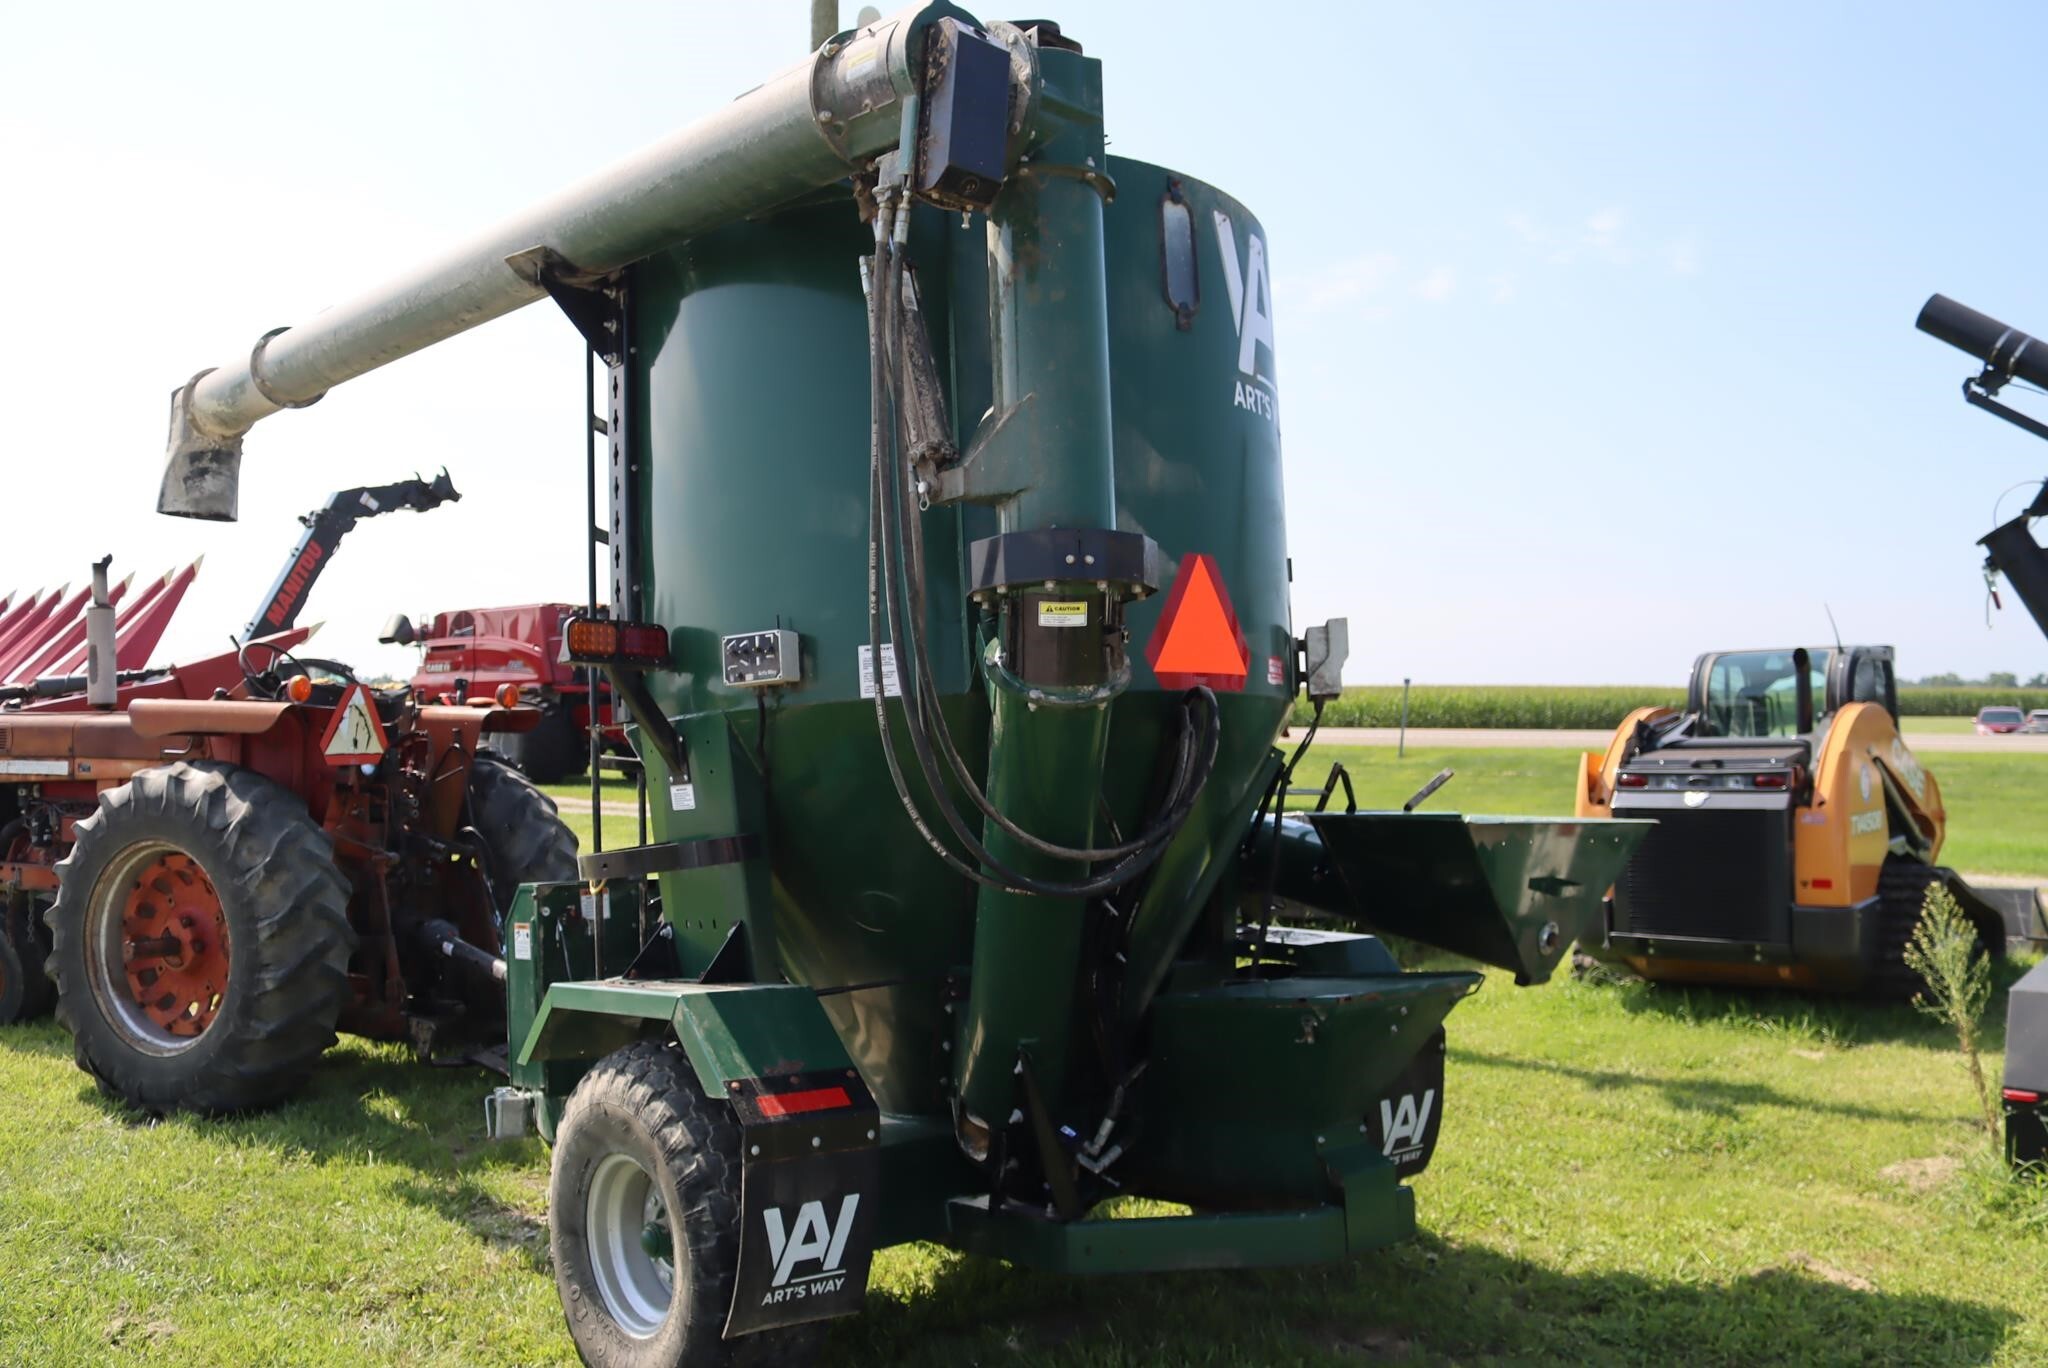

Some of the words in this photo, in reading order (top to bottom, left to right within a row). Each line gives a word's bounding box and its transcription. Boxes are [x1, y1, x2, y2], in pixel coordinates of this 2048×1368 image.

[1234, 380, 1271, 421] ART'S
[266, 540, 324, 627] MANITOU
[761, 1285, 807, 1306] ART'S
[810, 1277, 845, 1296] WAY
